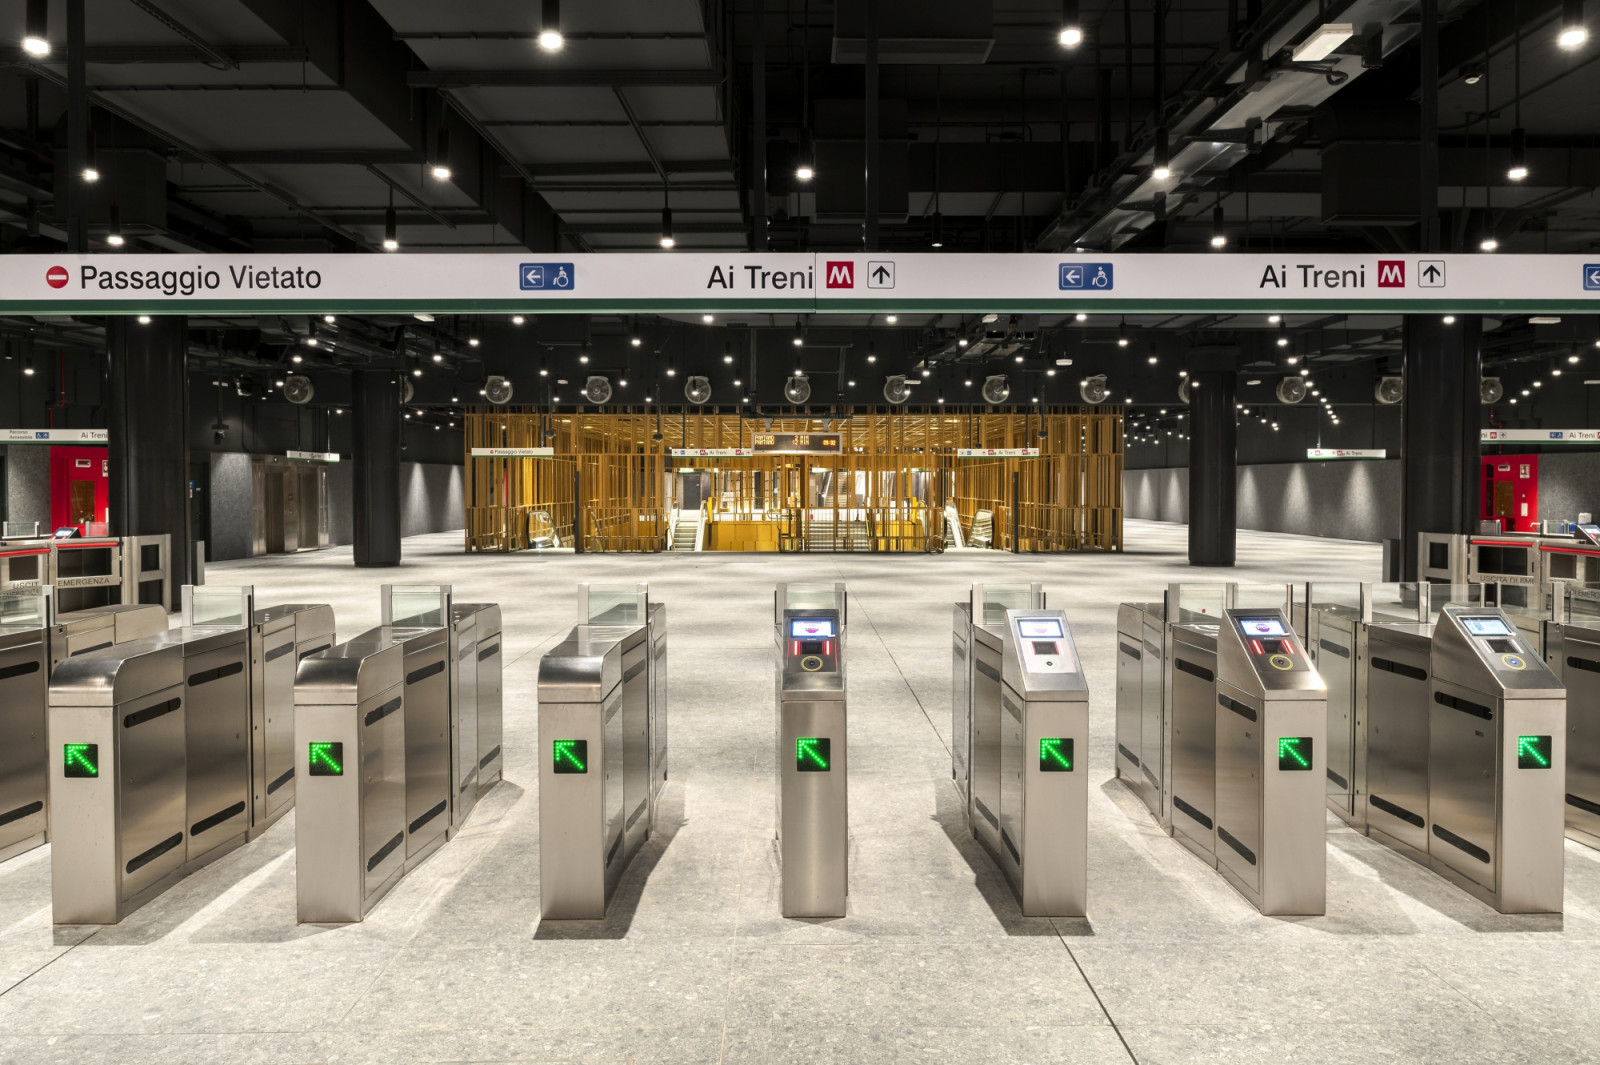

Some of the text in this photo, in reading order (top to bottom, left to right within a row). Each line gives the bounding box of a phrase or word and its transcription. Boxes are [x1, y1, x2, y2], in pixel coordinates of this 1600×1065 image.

[80, 265, 322, 297] Passaggio Vietato
[706, 265, 734, 290] Ai
[743, 265, 814, 290] Treni
[1259, 264, 1287, 289] Ai
[1296, 264, 1366, 289] Treni
[58, 578, 110, 586] EMERGENZA
